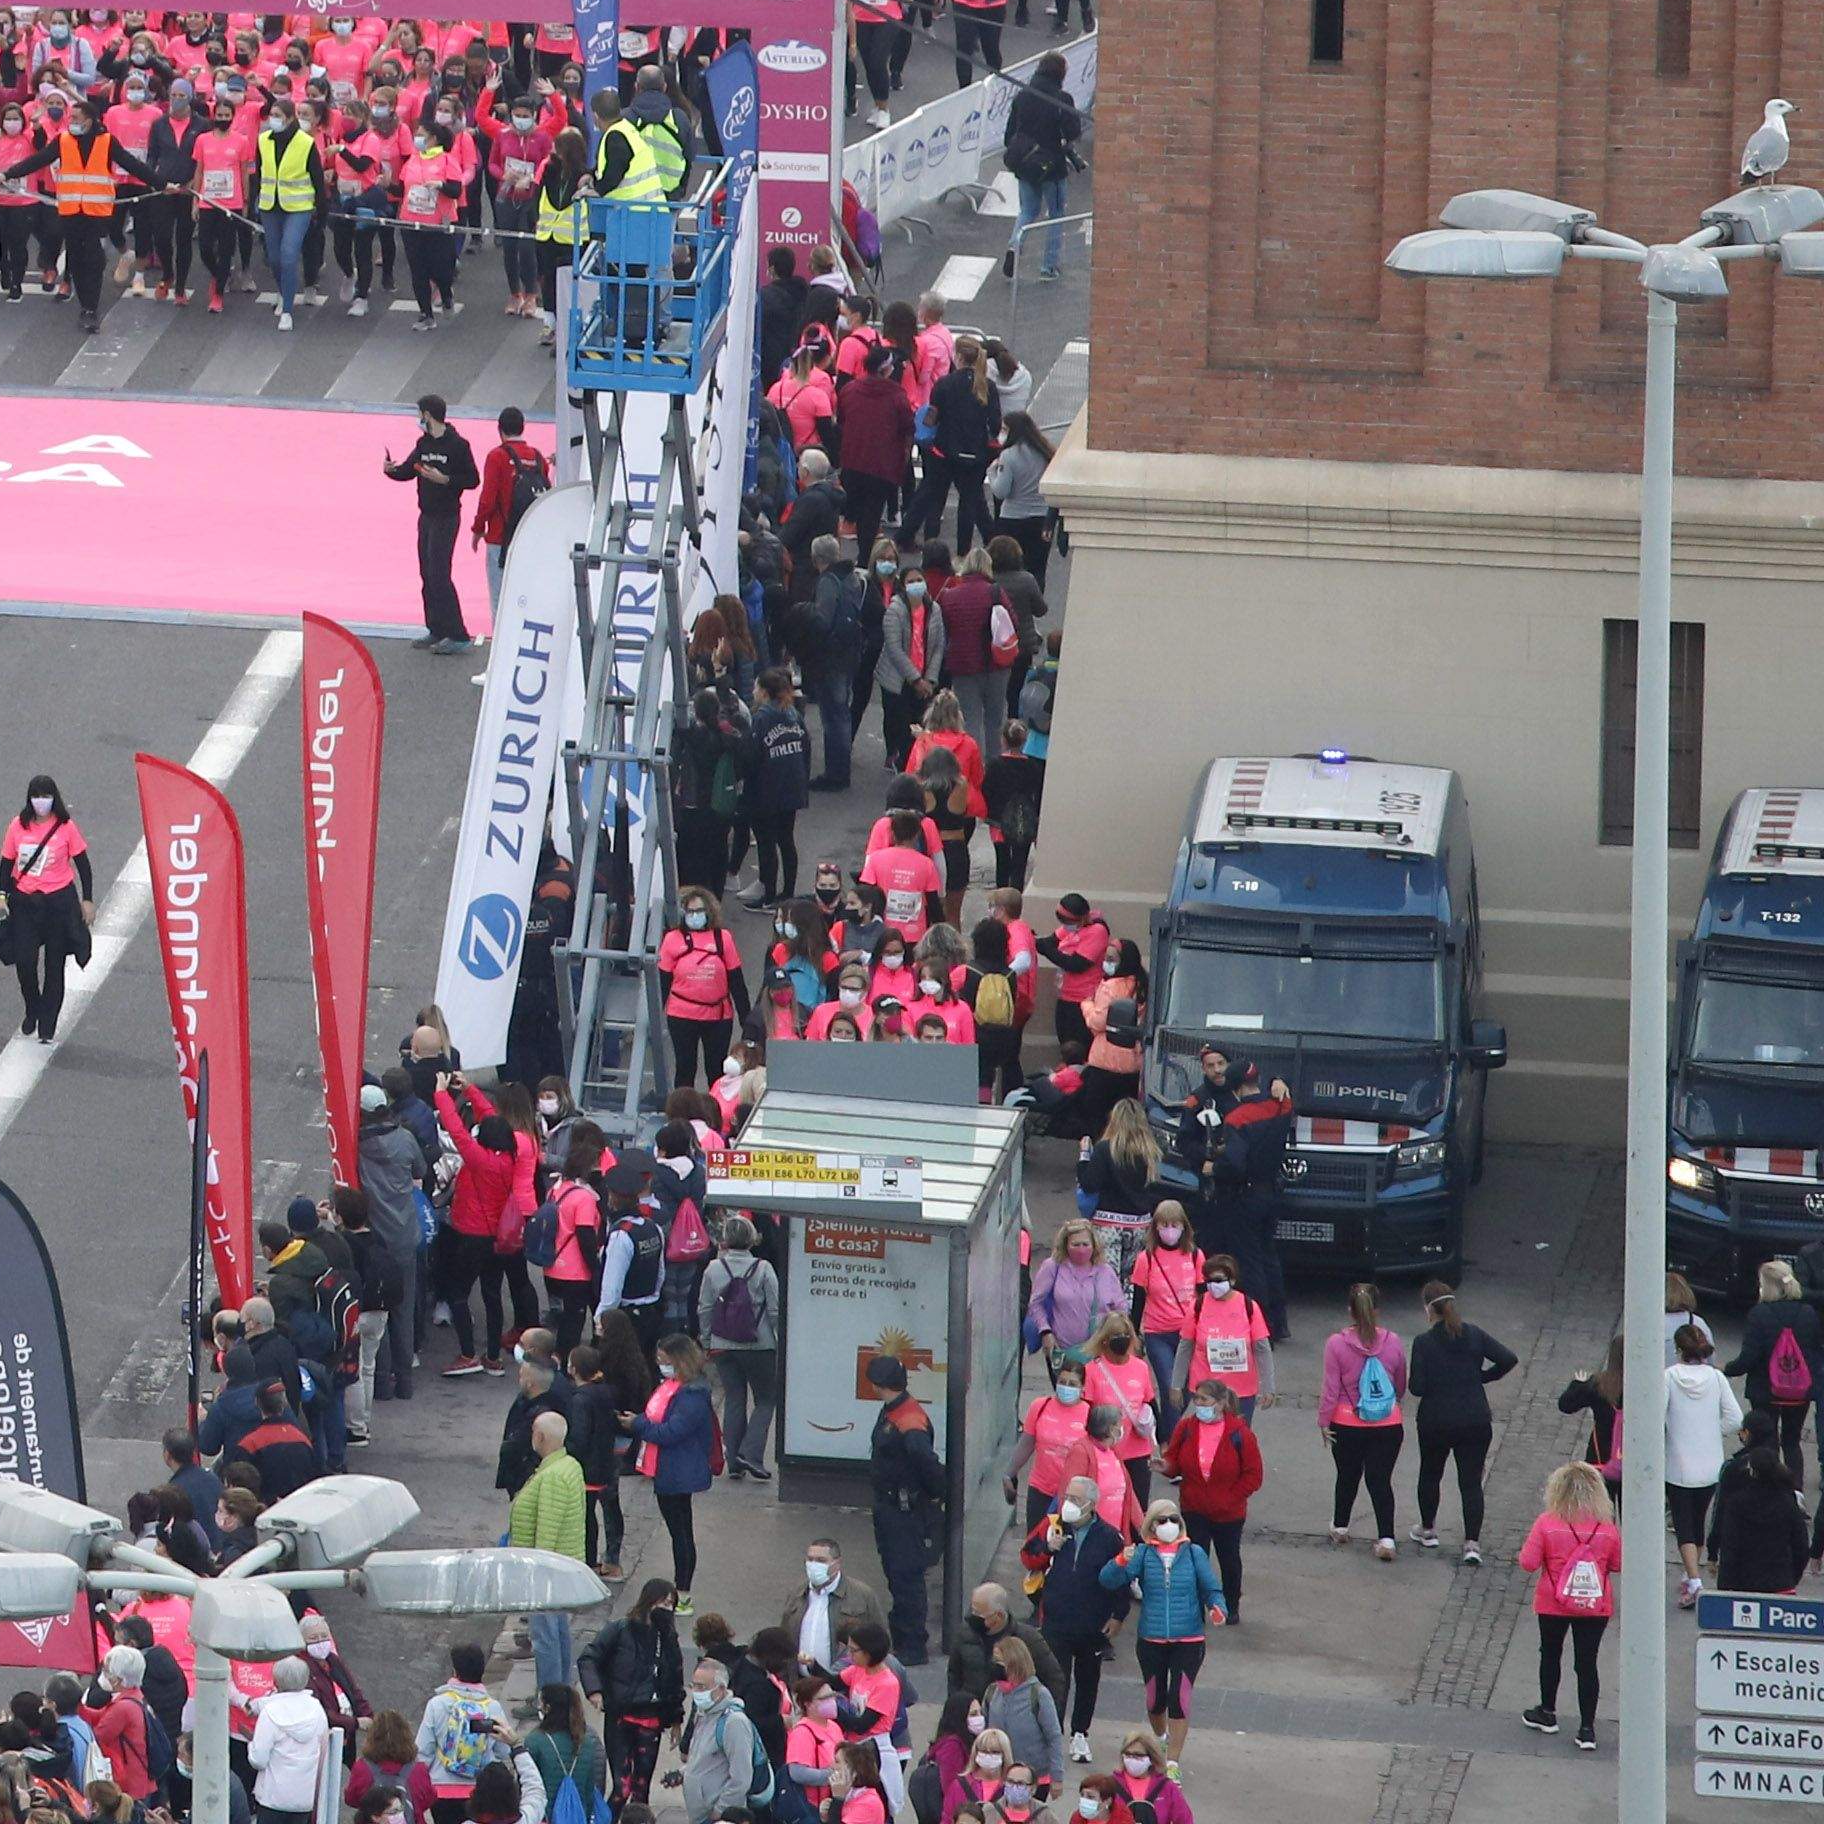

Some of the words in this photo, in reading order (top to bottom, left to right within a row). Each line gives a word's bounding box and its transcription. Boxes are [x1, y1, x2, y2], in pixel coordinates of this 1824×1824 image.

[760, 50, 823, 67] ASTURIANA
[759, 102, 828, 122] OYSHO
[773, 161, 821, 174] Santander
[765, 230, 819, 245] ZURICH
[40, 433, 153, 459] A
[485, 619, 554, 864] ZURICH
[1760, 911, 1802, 924] T-132
[712, 1152, 725, 1163] 13
[733, 1154, 747, 1164] 23
[752, 1154, 770, 1164] L81
[708, 1166, 727, 1177] 902
[730, 1168, 750, 1177] E70
[818, 1171, 836, 1180] L72
[815, 1236, 835, 1249] de
[838, 1239, 881, 1253] casa?
[844, 1261, 878, 1275] gratis
[810, 1275, 849, 1287] puntos
[852, 1275, 866, 1286] de
[868, 1276, 917, 1291] recogida
[810, 1288, 840, 1298] cerca
[842, 1288, 856, 1298] de
[859, 1290, 867, 1299] ti
[1768, 1606, 1818, 1629] Parc
[1735, 1650, 1820, 1675] Escales
